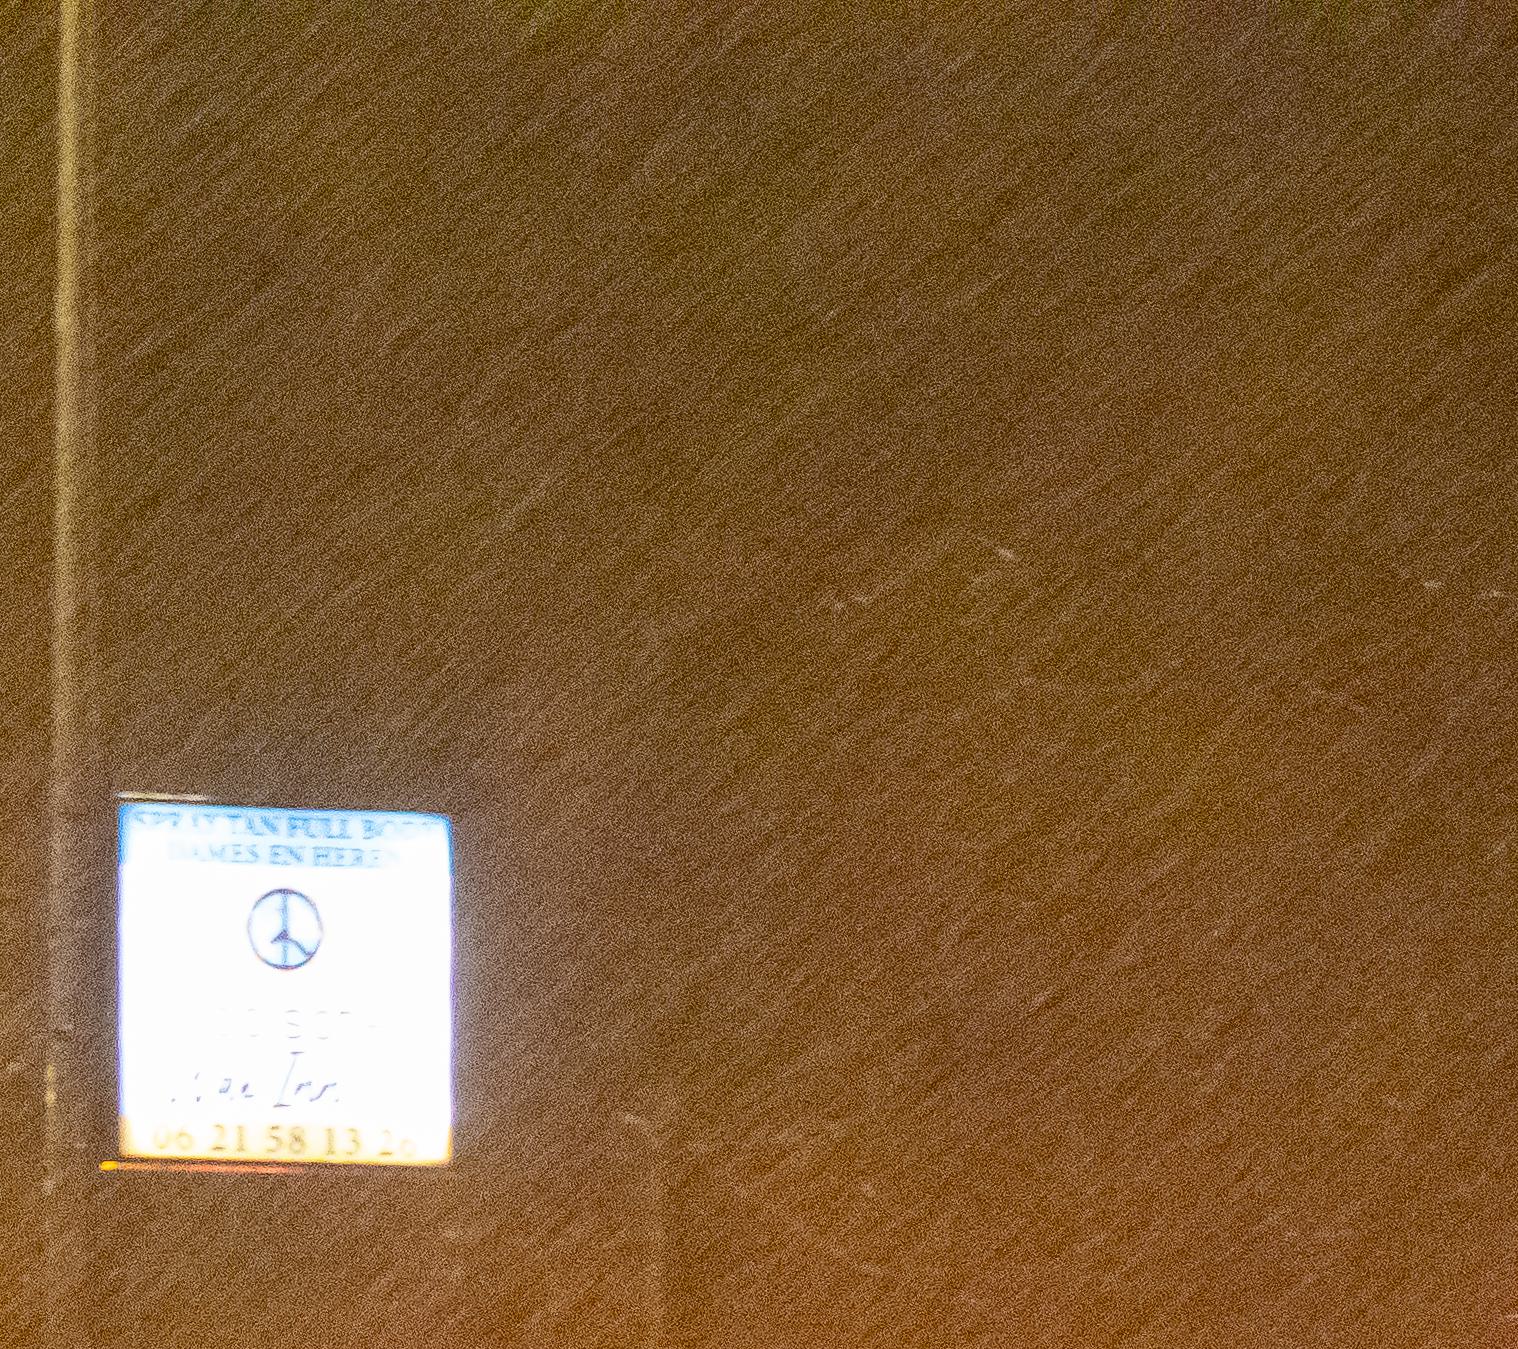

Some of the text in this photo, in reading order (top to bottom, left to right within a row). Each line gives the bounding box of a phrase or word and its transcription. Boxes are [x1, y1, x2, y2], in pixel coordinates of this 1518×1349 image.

[314, 846, 401, 868] HERE
[210, 1123, 246, 1154] 21
[265, 1124, 308, 1155] 58
[324, 1126, 363, 1156] 13
